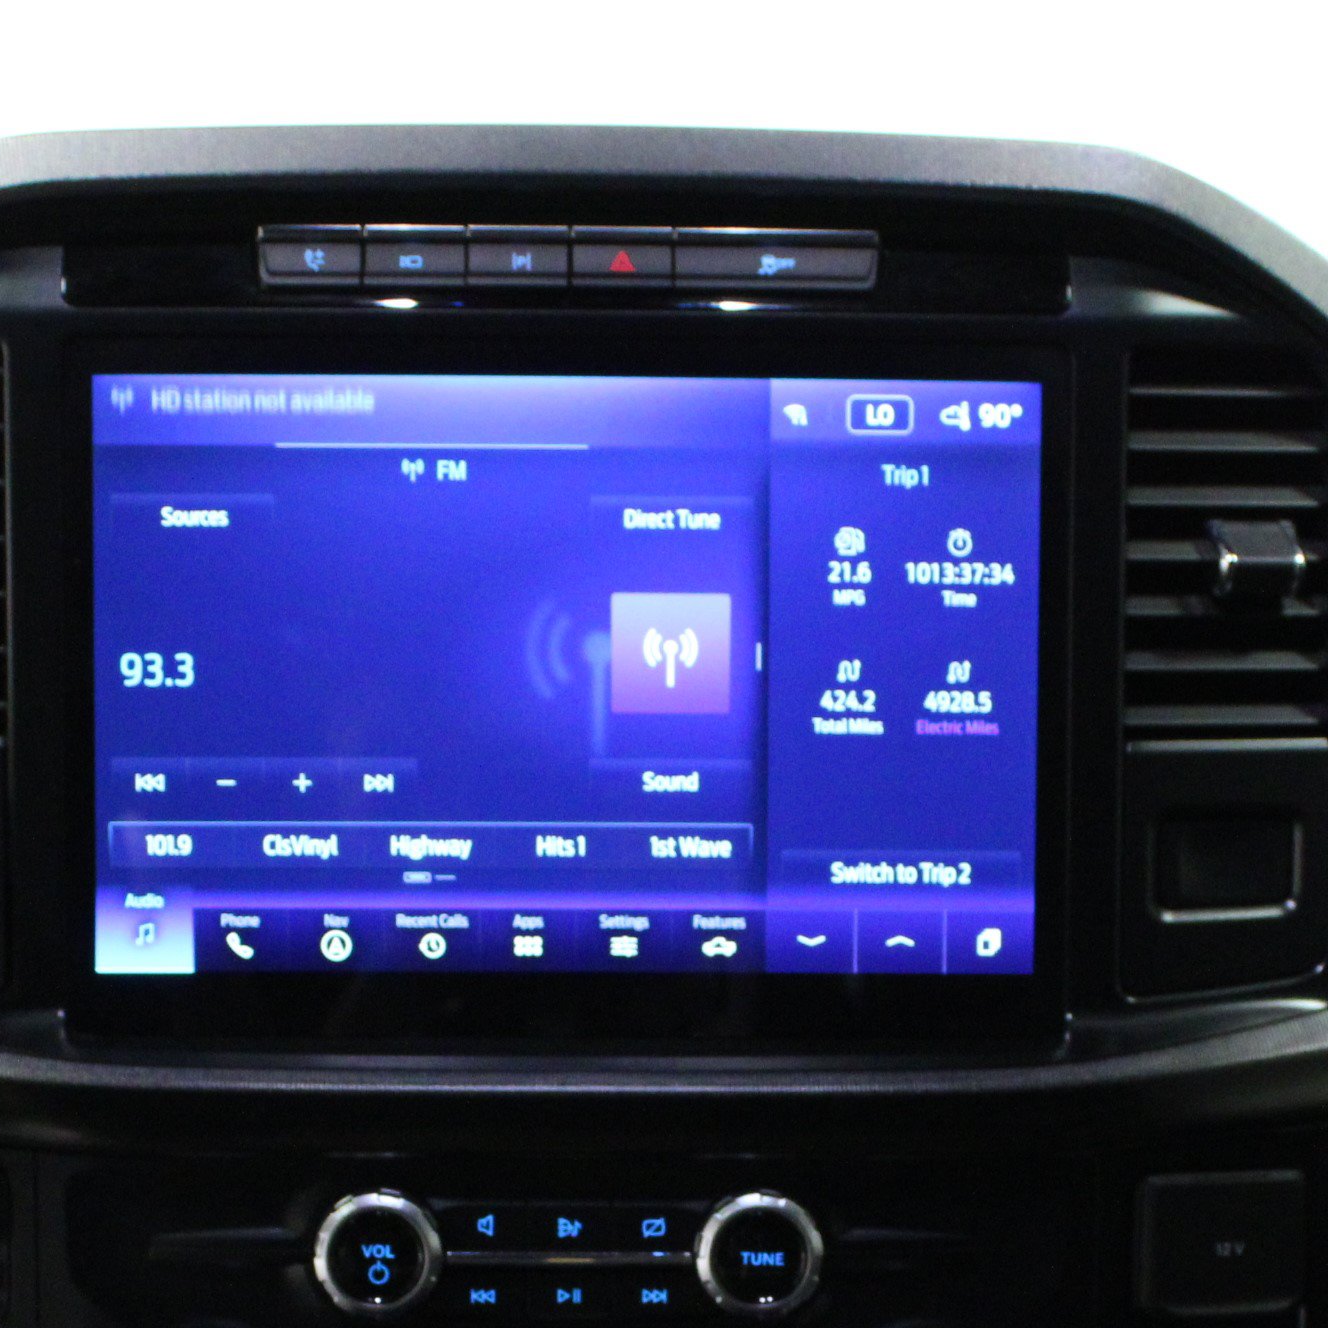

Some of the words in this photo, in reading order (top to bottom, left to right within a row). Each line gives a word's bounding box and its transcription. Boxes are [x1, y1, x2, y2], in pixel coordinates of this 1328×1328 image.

[151, 389, 181, 412] HD
[184, 390, 251, 413] station
[254, 390, 287, 413] not
[290, 390, 375, 413] available
[866, 403, 895, 426] LO
[979, 402, 1023, 428] 90°
[436, 460, 468, 481] FM
[882, 464, 919, 489] Trip
[920, 465, 930, 486] 1
[161, 507, 229, 527] Sources
[623, 508, 675, 530] Direct
[677, 509, 721, 530] Tune
[827, 561, 872, 585] 21.6
[905, 562, 1015, 585] 1013:37:34
[832, 588, 867, 607] MPG
[941, 590, 978, 608] Time
[119, 652, 196, 688] 93.3
[819, 690, 877, 712] 424.2
[923, 690, 993, 714] 4928.5
[812, 717, 848, 735] Total
[848, 718, 884, 735] Miles
[915, 719, 963, 735] Electric
[965, 719, 1000, 735] Miles
[642, 771, 699, 792] Sound
[145, 834, 193, 856] 101.9
[262, 834, 339, 859] ClsVinyl
[389, 834, 473, 861] Highway
[536, 836, 576, 857] Hits
[577, 837, 587, 857] 1
[650, 836, 678, 858] 1st
[679, 837, 733, 859] Wave
[830, 861, 895, 885] Switch
[896, 863, 917, 884] to
[918, 862, 956, 887] Trip
[957, 863, 972, 885] 2
[124, 892, 166, 910] Audio
[220, 912, 261, 929] Phone
[323, 913, 350, 928] Nav
[395, 913, 438, 929] Recent
[439, 913, 470, 929] Calls
[512, 913, 545, 931] Apps
[598, 913, 650, 931] Settings
[692, 914, 747, 931] Features
[361, 1244, 395, 1260] VOL
[740, 1251, 785, 1267] TUNE
